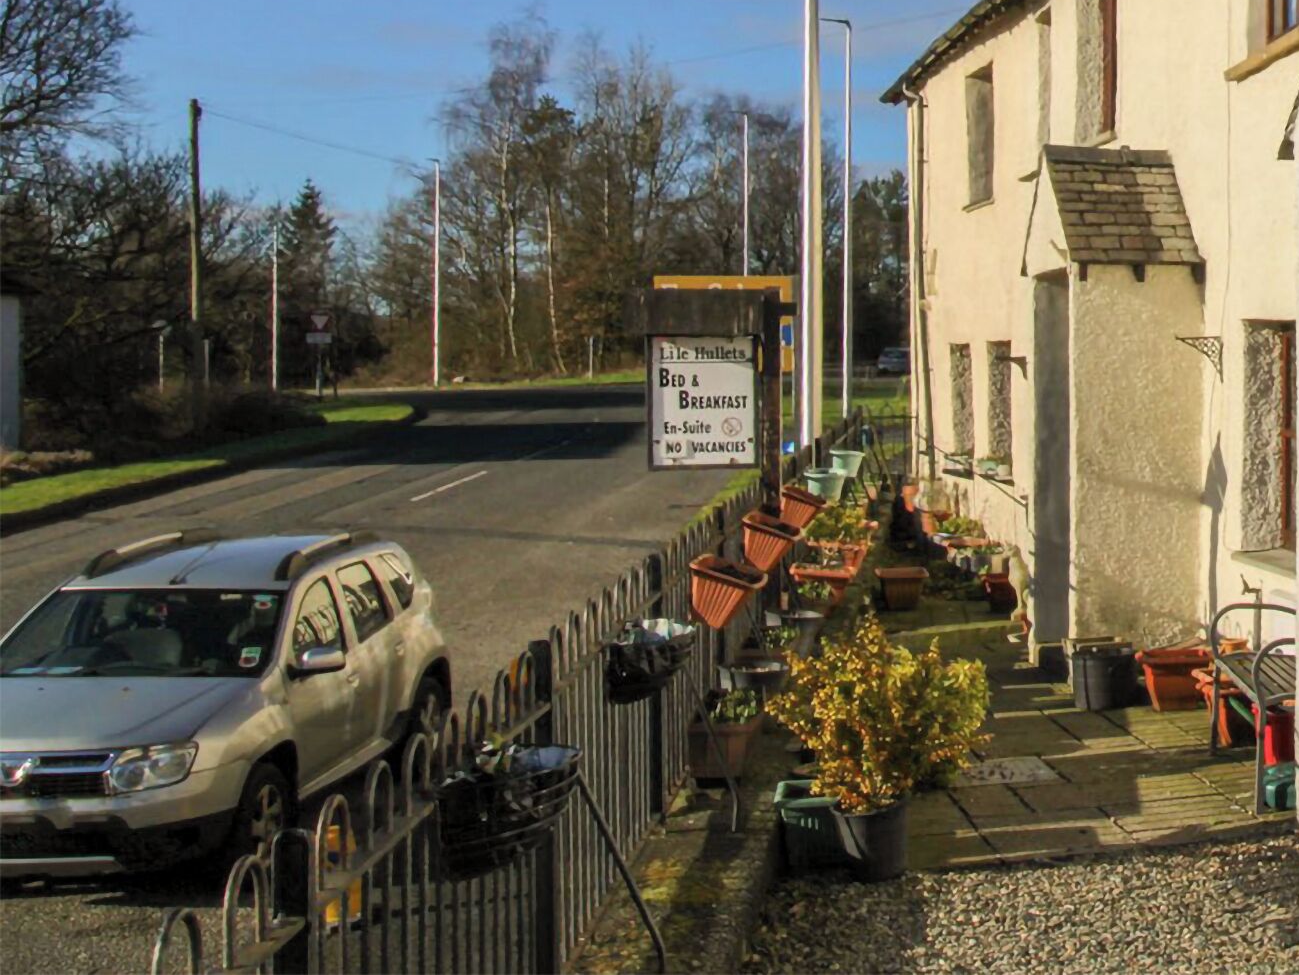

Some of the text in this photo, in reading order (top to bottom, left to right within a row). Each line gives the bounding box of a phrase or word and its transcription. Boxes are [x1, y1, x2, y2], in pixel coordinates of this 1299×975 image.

[695, 346, 746, 360] Hullets
[691, 374, 699, 387] &
[679, 391, 748, 409] BREAKFAST
[664, 420, 711, 434] En-Suite
[666, 441, 746, 454] NO VACANCIES
